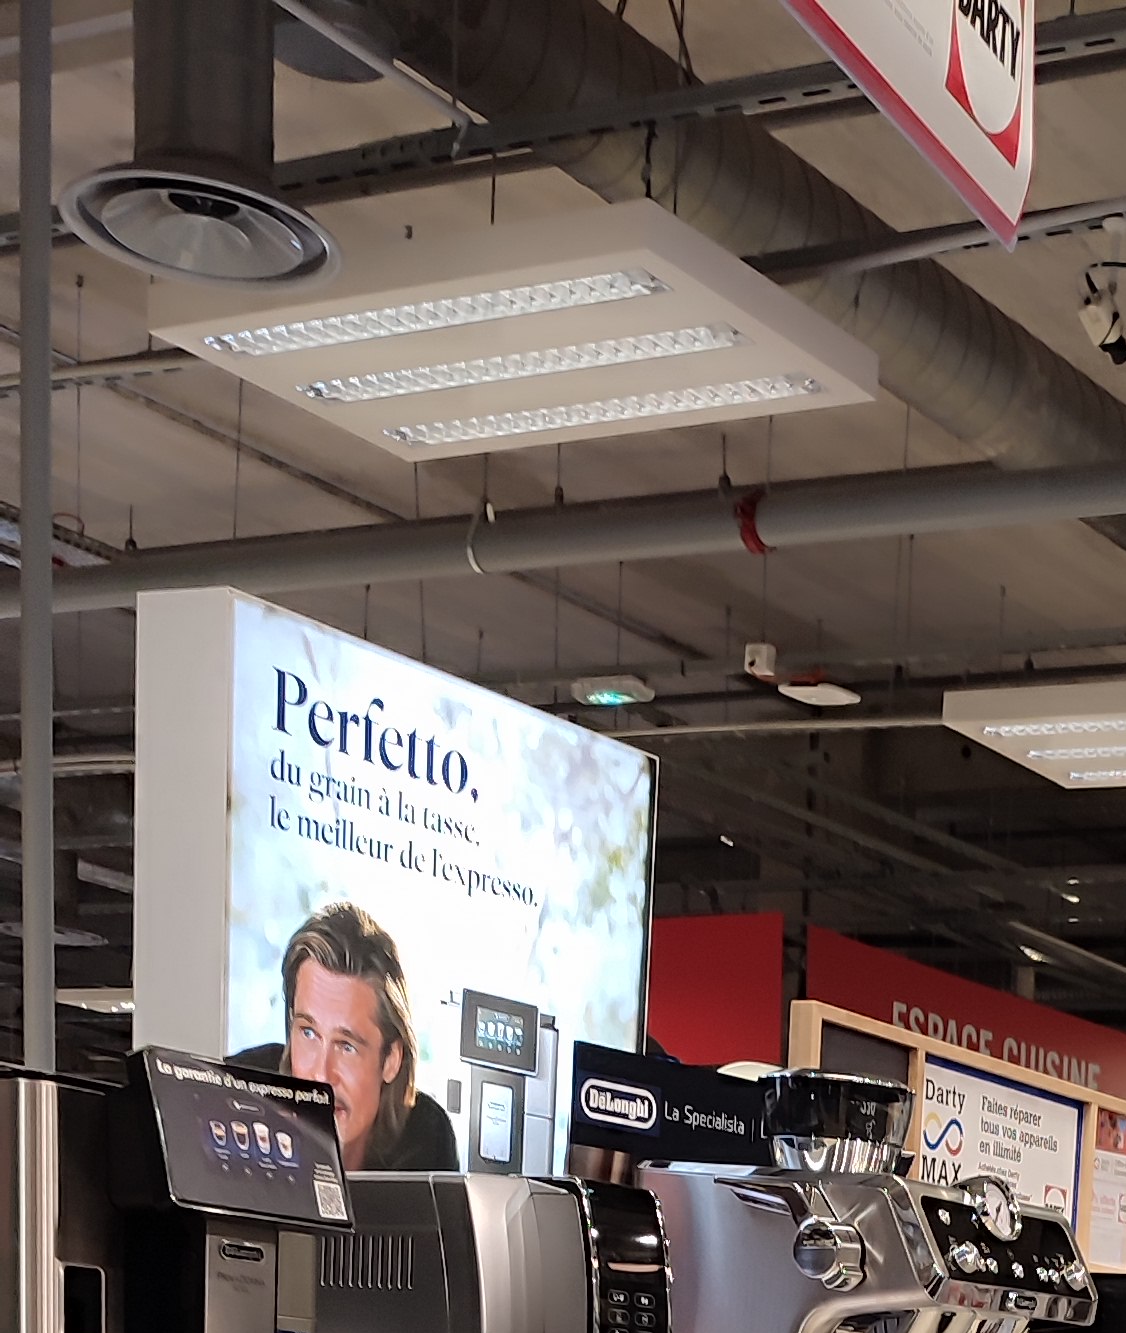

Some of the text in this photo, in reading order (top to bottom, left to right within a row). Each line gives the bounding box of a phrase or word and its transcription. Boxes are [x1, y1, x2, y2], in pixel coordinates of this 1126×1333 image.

[270, 749, 301, 787] du
[308, 770, 371, 811] grain
[378, 788, 390, 817] à
[398, 791, 416, 825] la
[268, 794, 538, 908] le meilleur de l'expresso.
[892, 1001, 1101, 1090] ESPACE CUISINE
[924, 1078, 966, 1115] Darty
[981, 1095, 1042, 1128] Faites réparer
[664, 1100, 680, 1122] La
[683, 1104, 745, 1136] Specialista
[980, 1116, 1058, 1153] tous vos appareils
[921, 1155, 962, 1185] MAX
[979, 1140, 1022, 1164] en illimité
